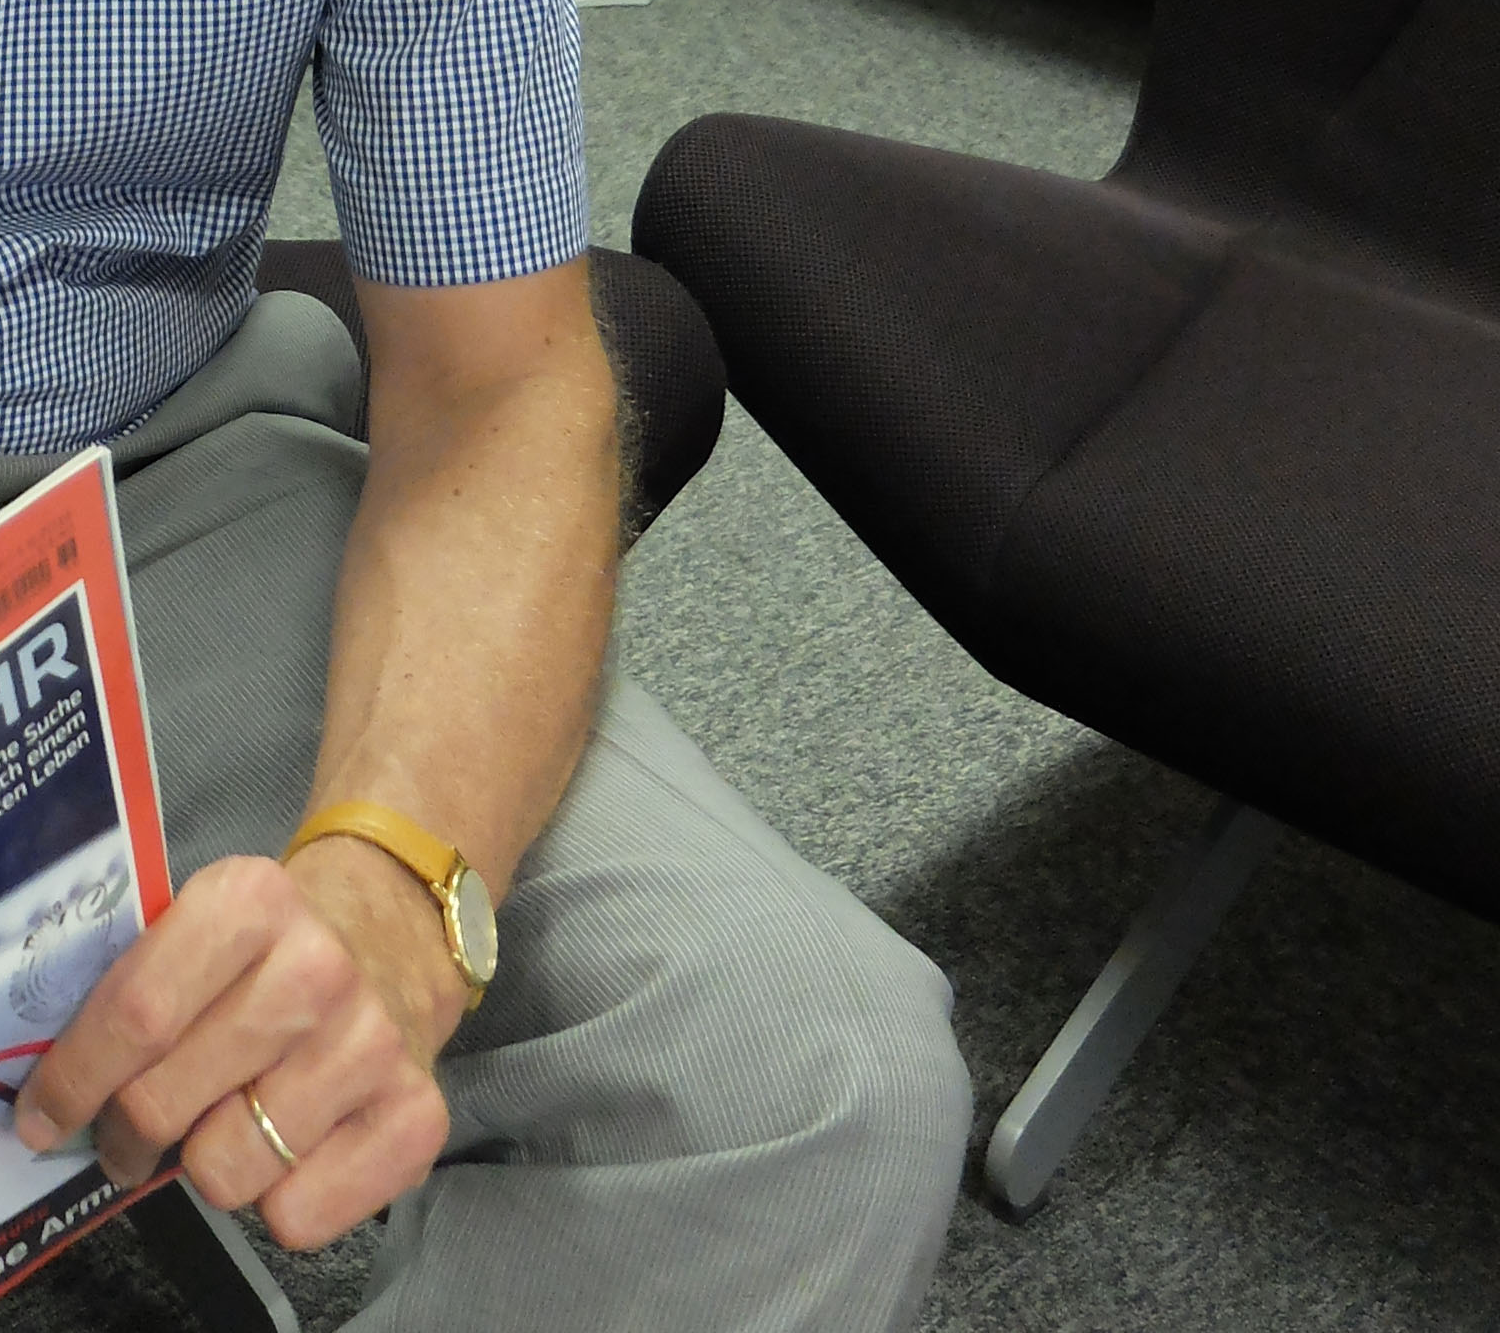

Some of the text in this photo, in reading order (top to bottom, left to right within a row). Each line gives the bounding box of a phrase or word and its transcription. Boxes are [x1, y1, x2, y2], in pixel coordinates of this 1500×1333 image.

[22, 687, 84, 749] Suche
[25, 709, 88, 776] einem
[30, 729, 92, 788] Leben
